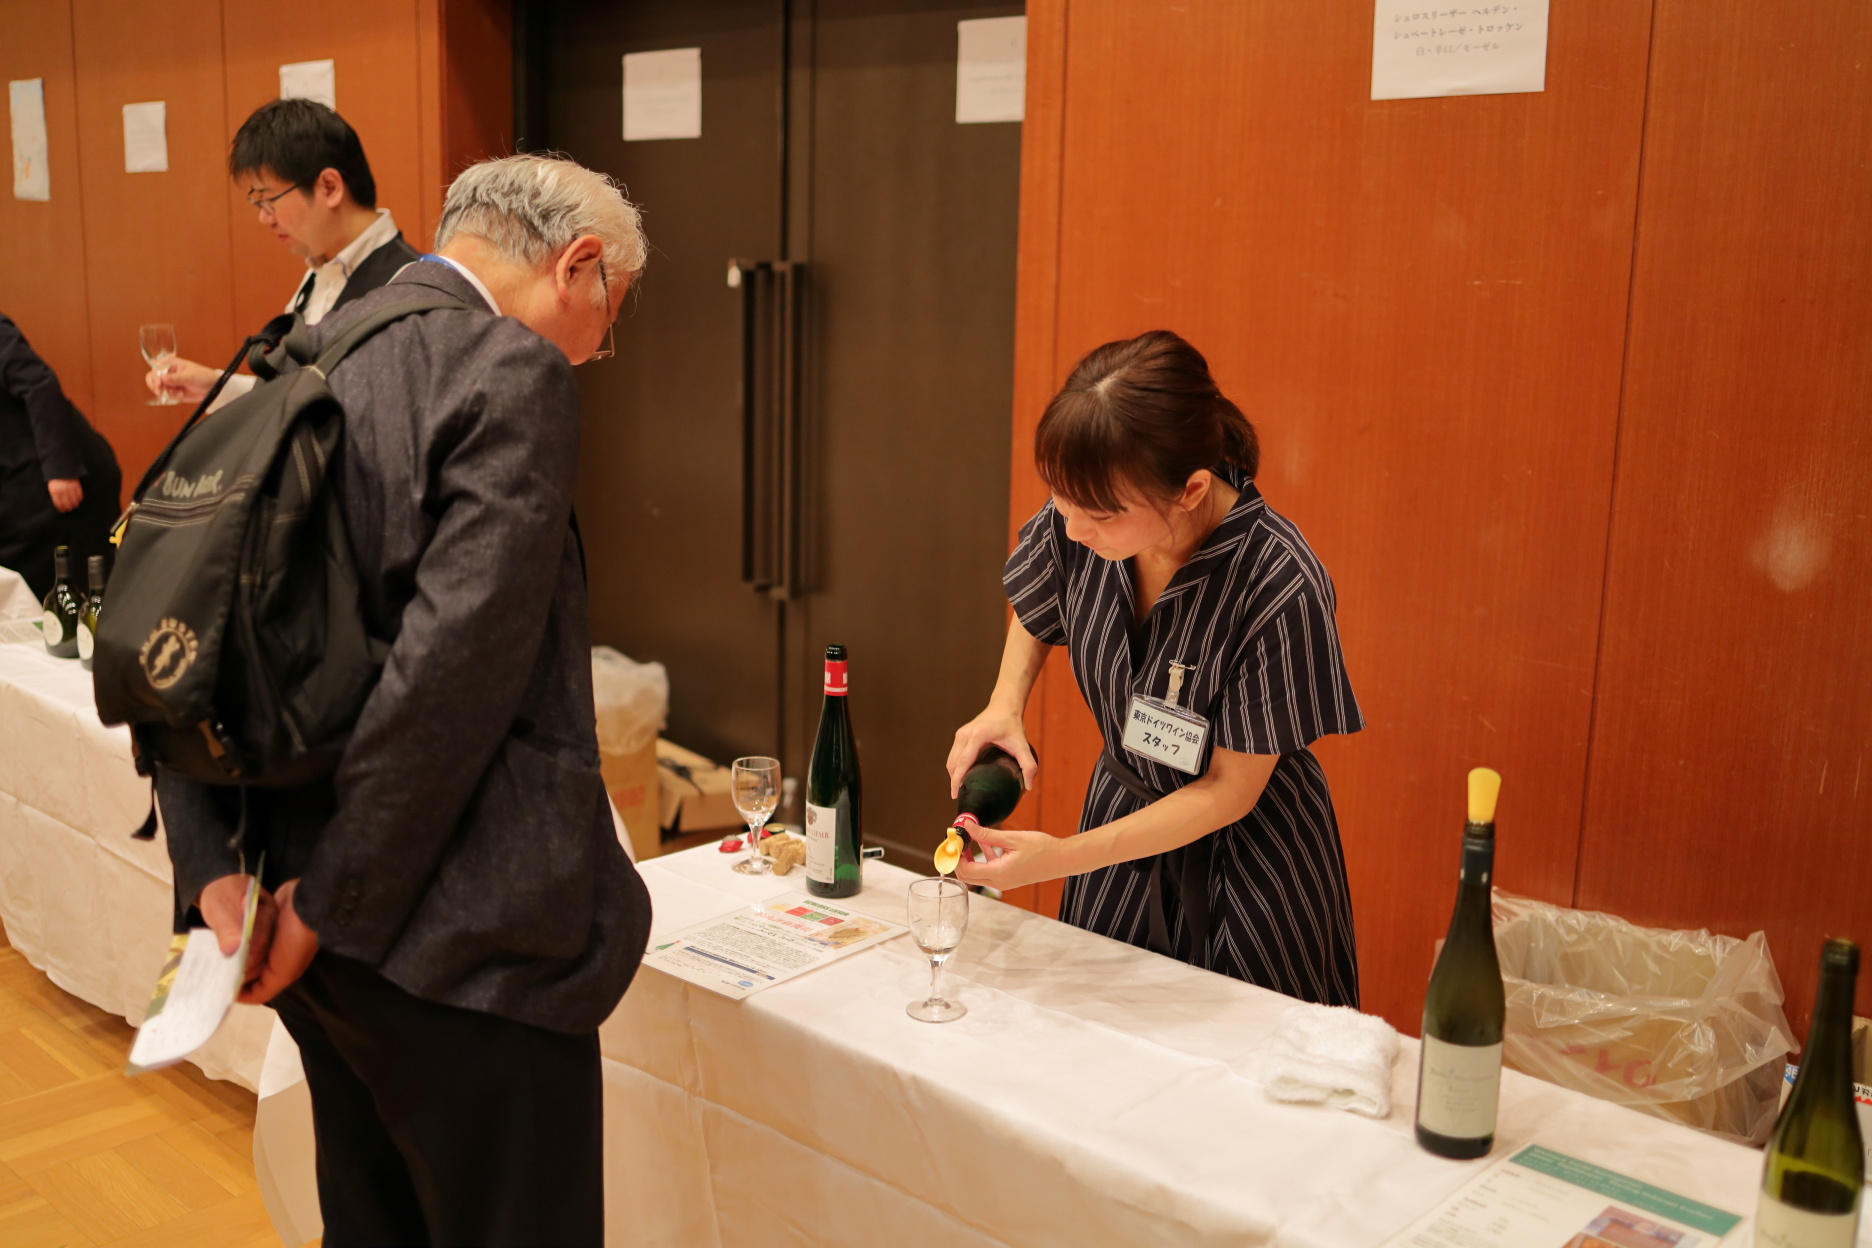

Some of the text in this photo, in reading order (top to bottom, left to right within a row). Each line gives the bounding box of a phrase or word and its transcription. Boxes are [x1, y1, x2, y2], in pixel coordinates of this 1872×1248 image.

[1133, 709, 1200, 745] 東京ドイツワイン協会
[1142, 732, 1180, 755] スタッフ
